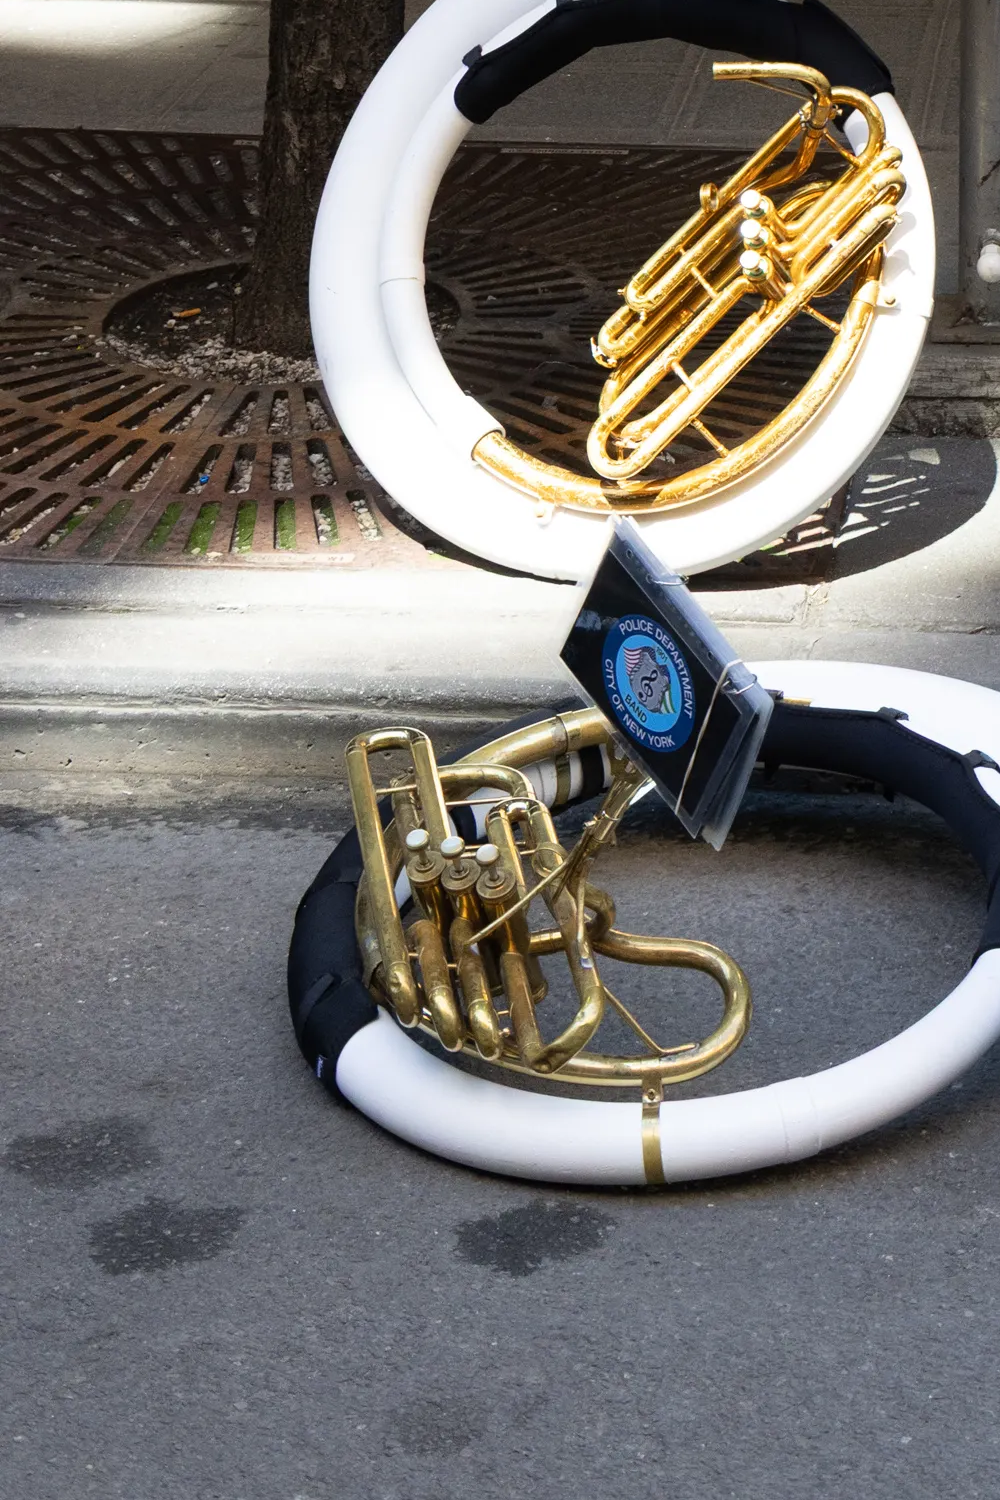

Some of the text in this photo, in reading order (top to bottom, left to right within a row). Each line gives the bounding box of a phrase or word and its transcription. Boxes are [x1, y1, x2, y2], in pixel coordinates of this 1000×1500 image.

[604, 658, 675, 749] CITY OF NEW YORK
[619, 618, 693, 719] POLICE DEPARTMENT
[624, 694, 648, 723] BAND
